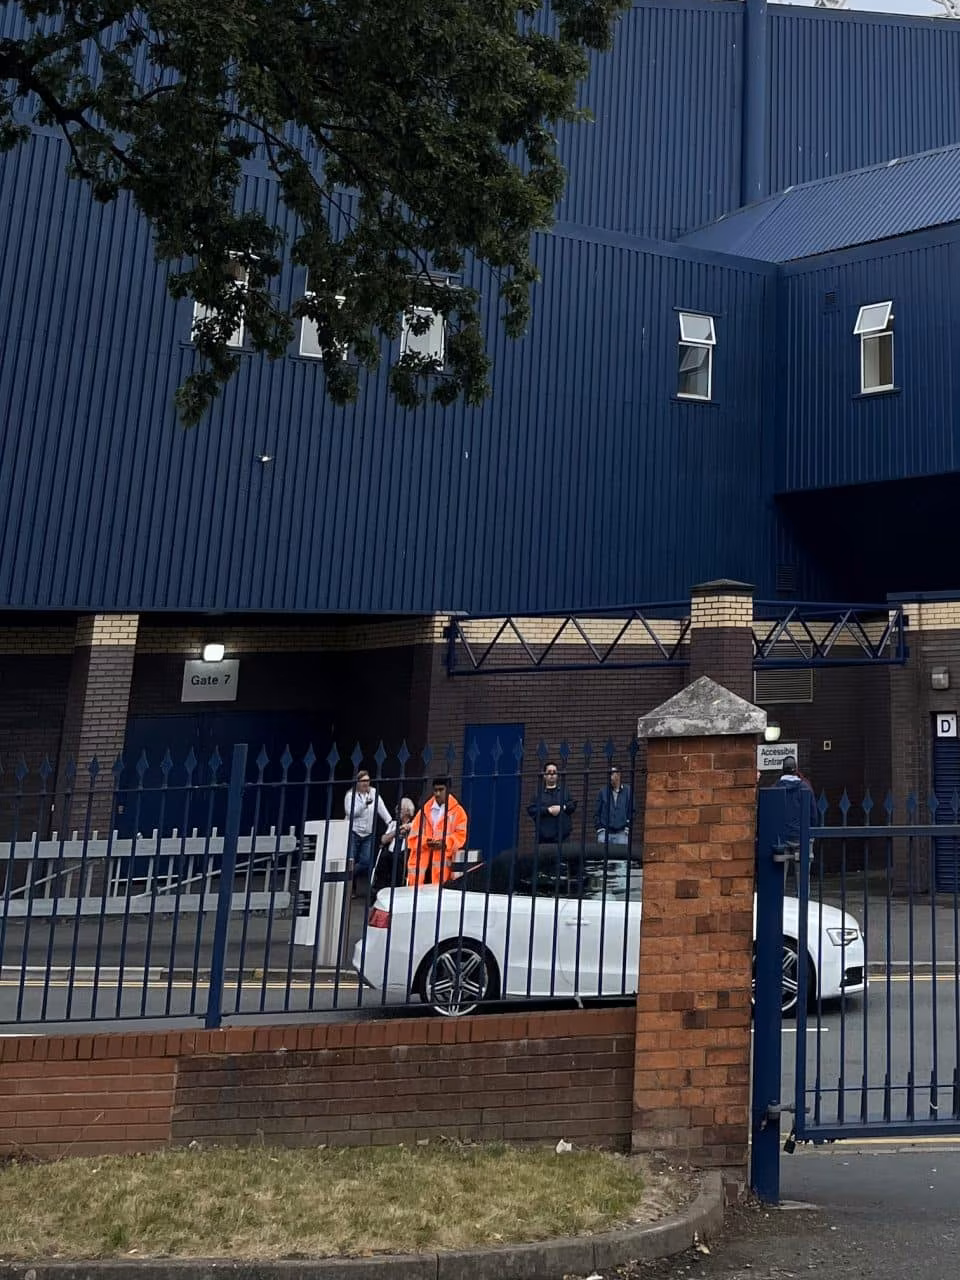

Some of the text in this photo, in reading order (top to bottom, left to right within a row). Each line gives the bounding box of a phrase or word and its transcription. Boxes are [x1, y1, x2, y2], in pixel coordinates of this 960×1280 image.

[191, 674, 231, 686] Gate 7
[761, 747, 795, 756] Accessible
